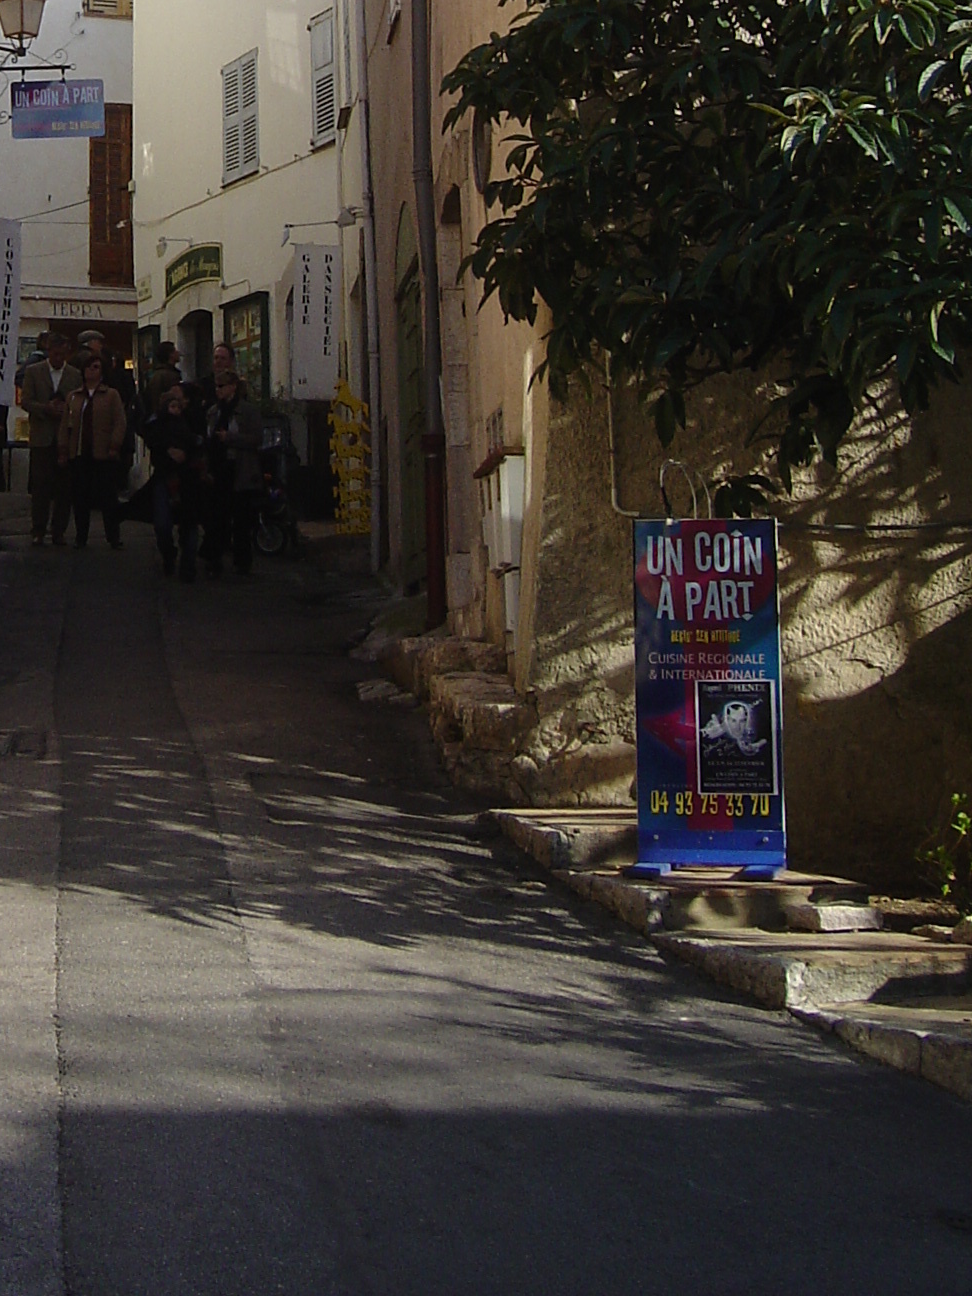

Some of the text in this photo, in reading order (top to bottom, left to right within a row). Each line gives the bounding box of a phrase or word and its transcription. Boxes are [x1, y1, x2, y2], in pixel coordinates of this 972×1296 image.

[15, 90, 29, 107] UN
[73, 86, 100, 104] PART
[301, 253, 311, 325] GALERIE
[52, 301, 103, 319] TERRA
[646, 535, 683, 576] UN
[656, 574, 754, 622] À PART
[648, 669, 658, 681] &
[650, 790, 769, 817] 04 93 75 33 70
